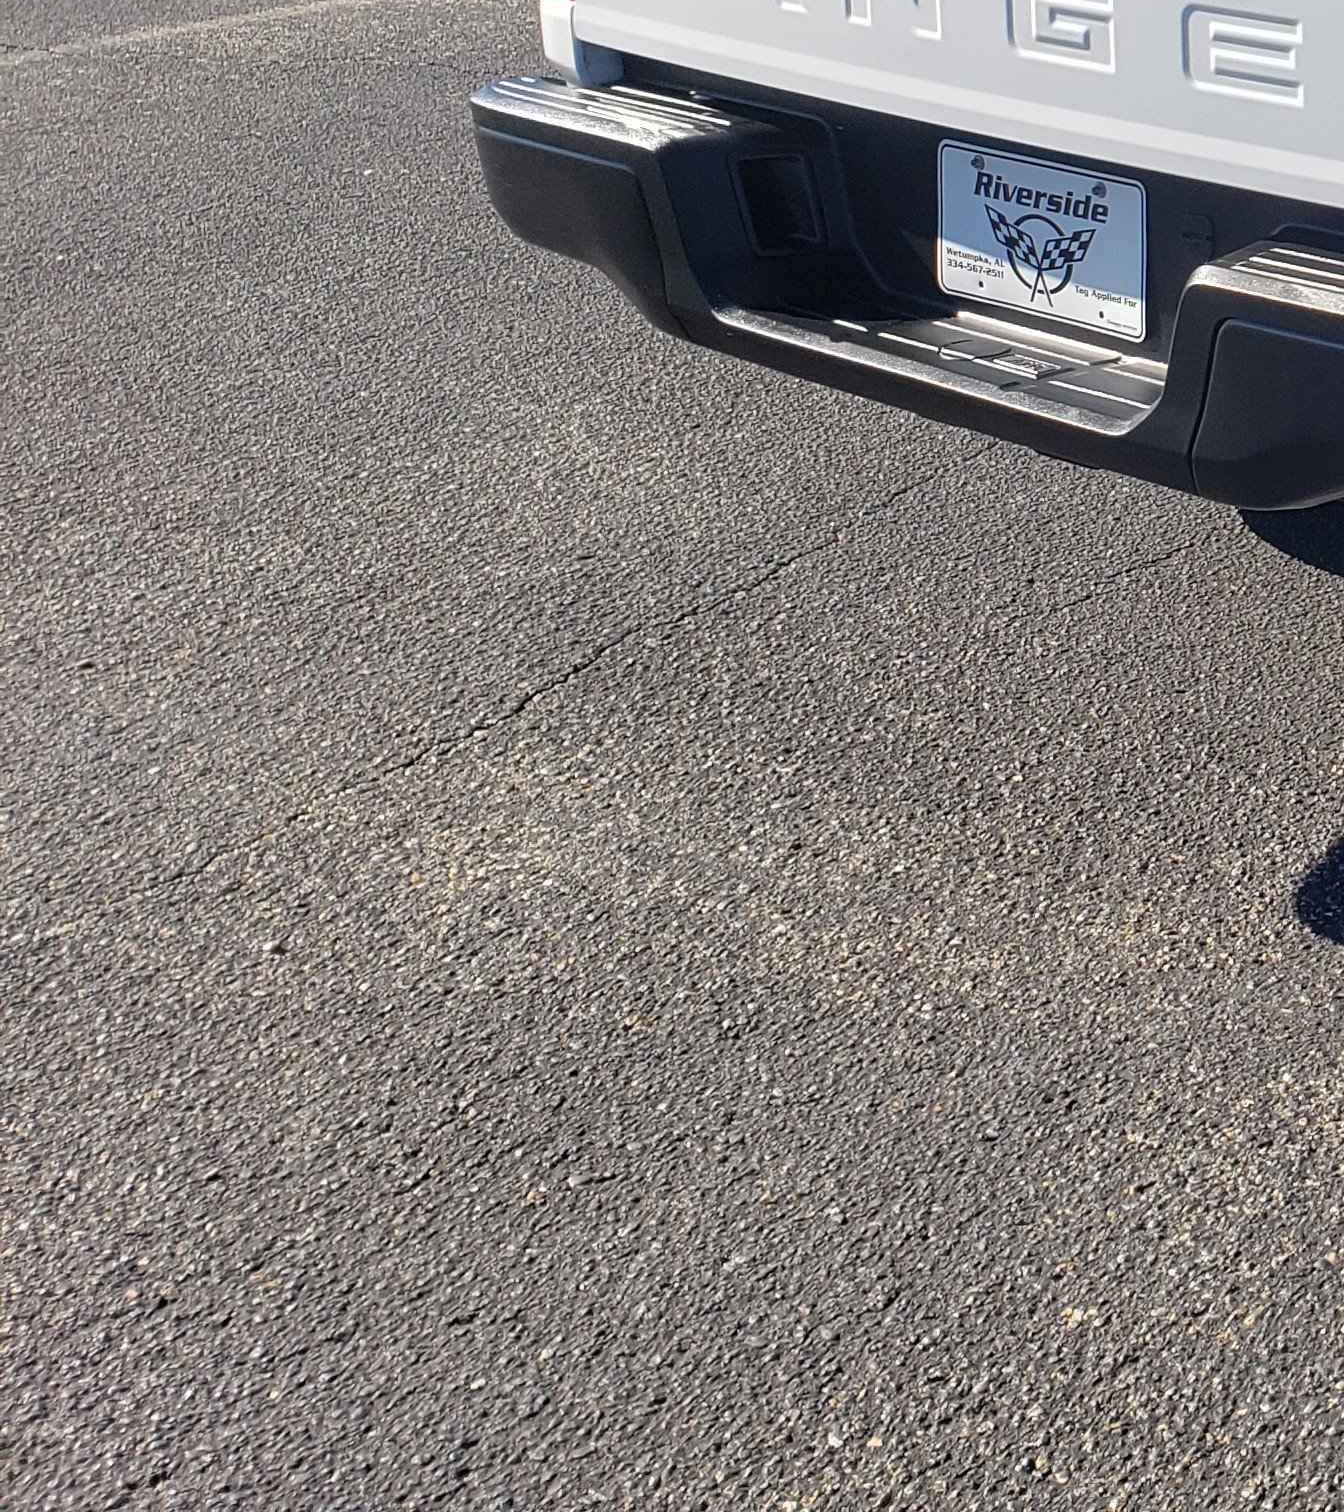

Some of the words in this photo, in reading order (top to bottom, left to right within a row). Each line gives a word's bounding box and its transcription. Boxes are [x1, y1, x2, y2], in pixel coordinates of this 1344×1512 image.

[973, 171, 1109, 224] Riverside
[946, 258, 1004, 279] 334-567-2511
[994, 258, 1005, 268] AL
[1074, 285, 1089, 297] Tag
[1091, 289, 1122, 304] Applied
[1124, 297, 1138, 308] For
